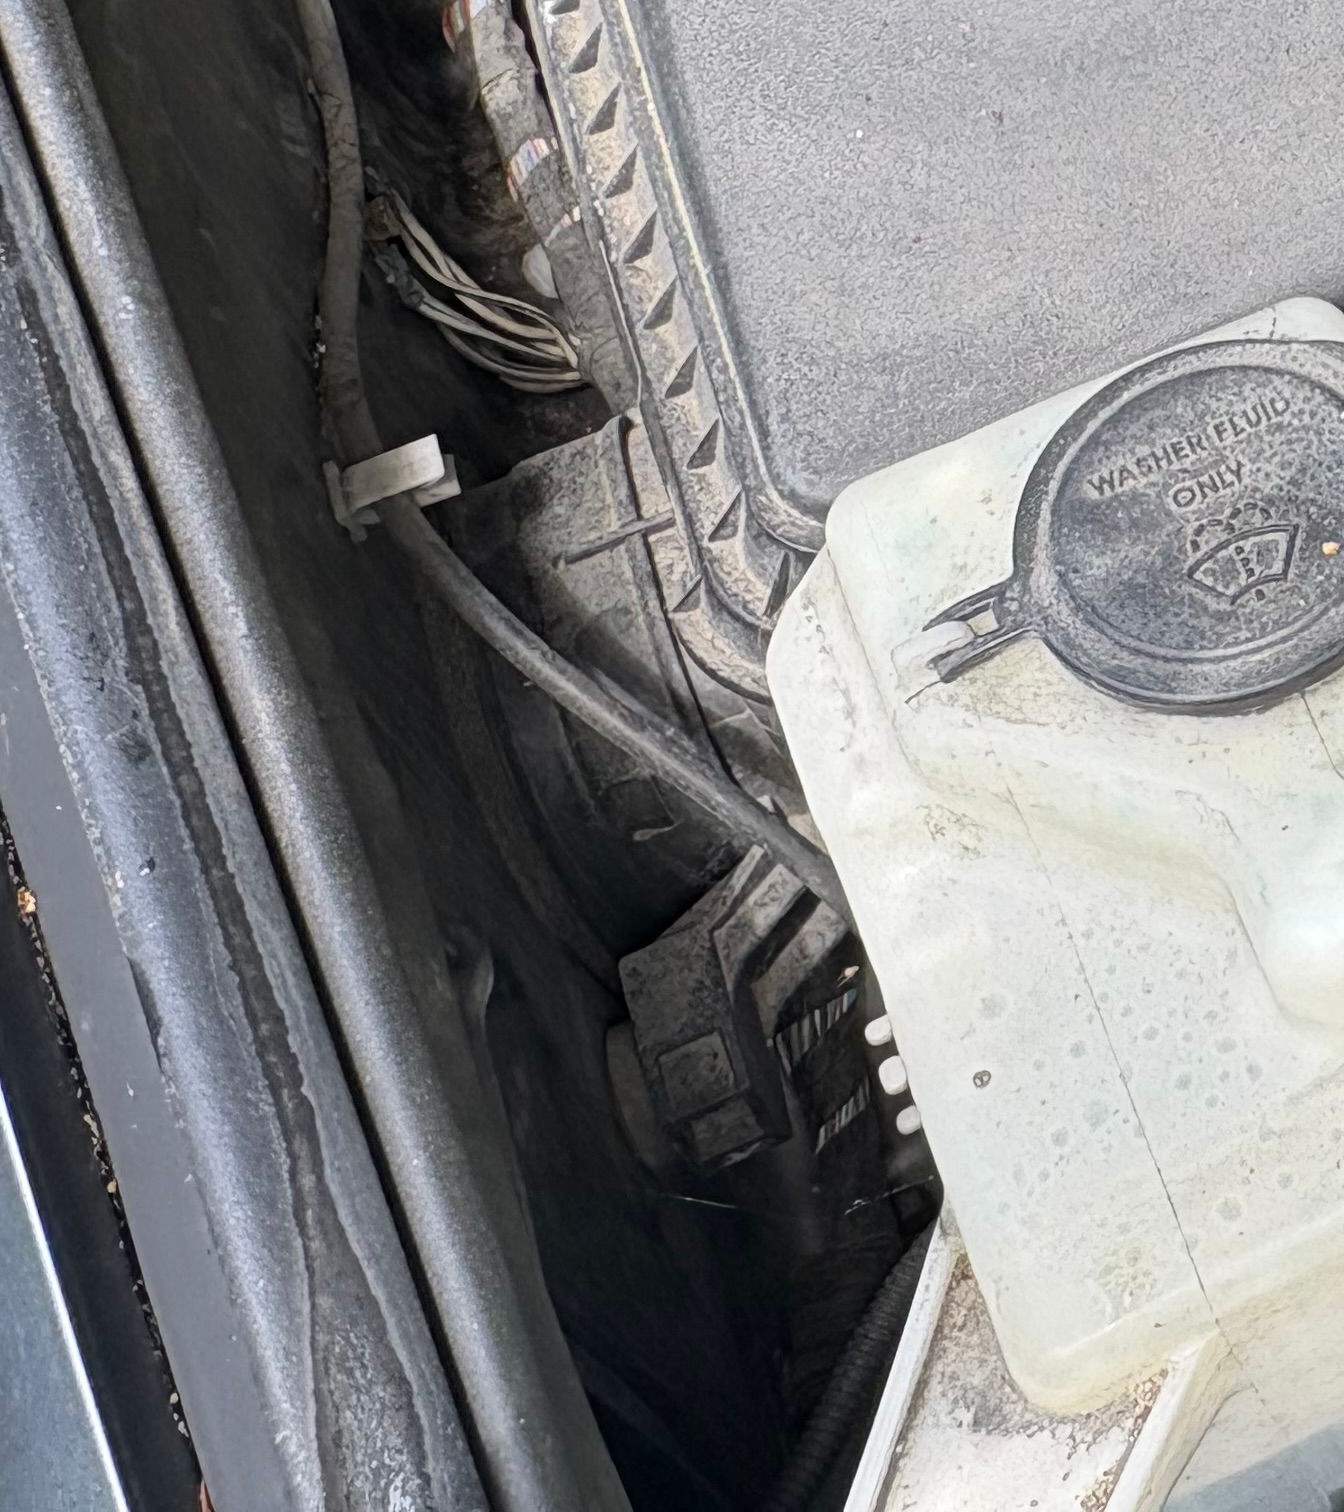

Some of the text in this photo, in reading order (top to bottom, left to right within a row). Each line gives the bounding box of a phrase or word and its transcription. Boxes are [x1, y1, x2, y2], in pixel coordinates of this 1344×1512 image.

[1087, 396, 1290, 497] WASHER FLUID
[1172, 460, 1246, 508] ONLY
